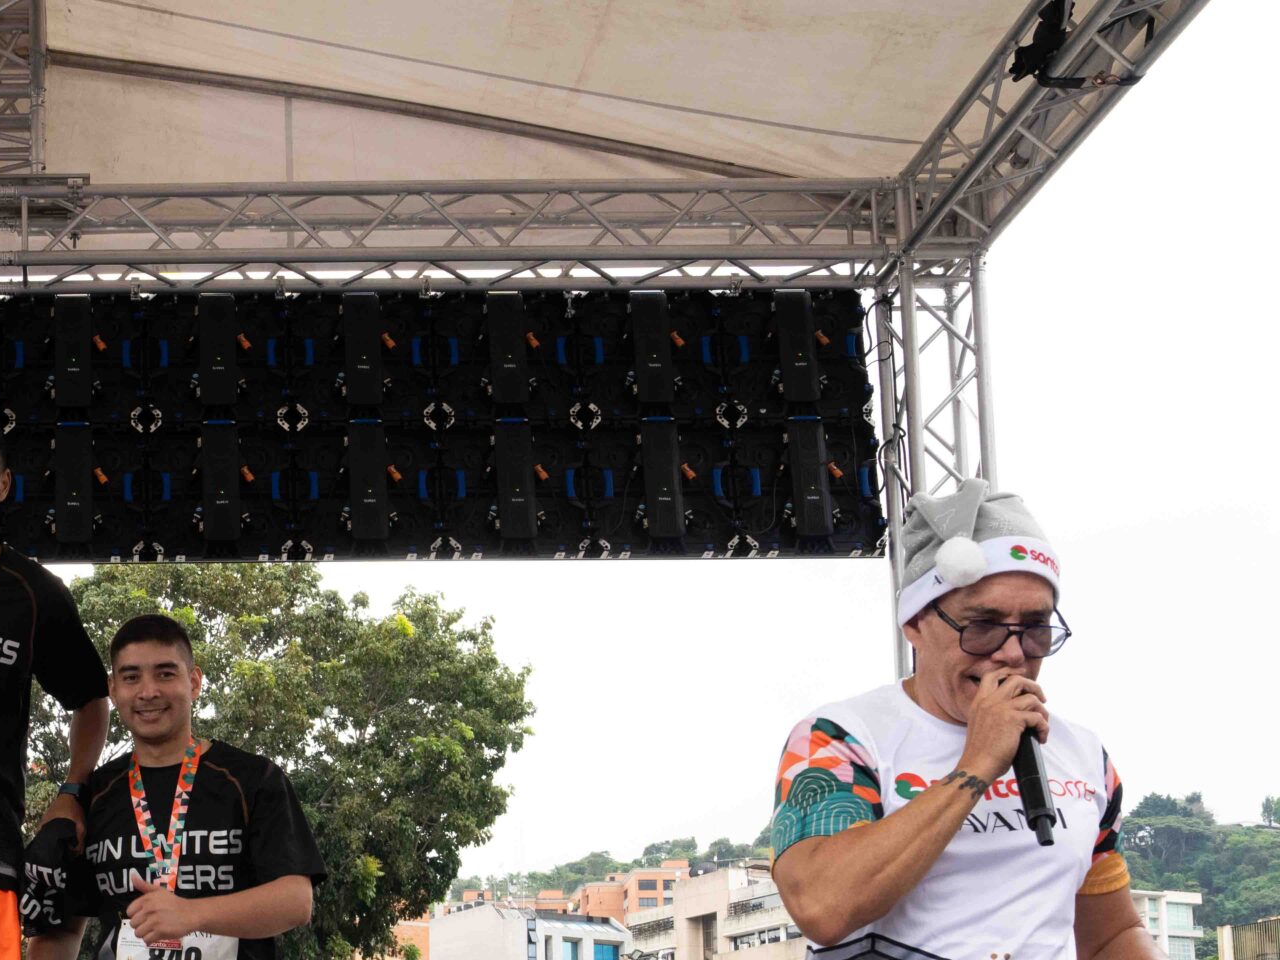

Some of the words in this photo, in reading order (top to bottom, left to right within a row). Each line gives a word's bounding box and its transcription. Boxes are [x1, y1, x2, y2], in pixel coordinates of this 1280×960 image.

[959, 807, 1068, 834] AVAI
[131, 829, 243, 858] LITES
[96, 864, 234, 896] RUNERS
